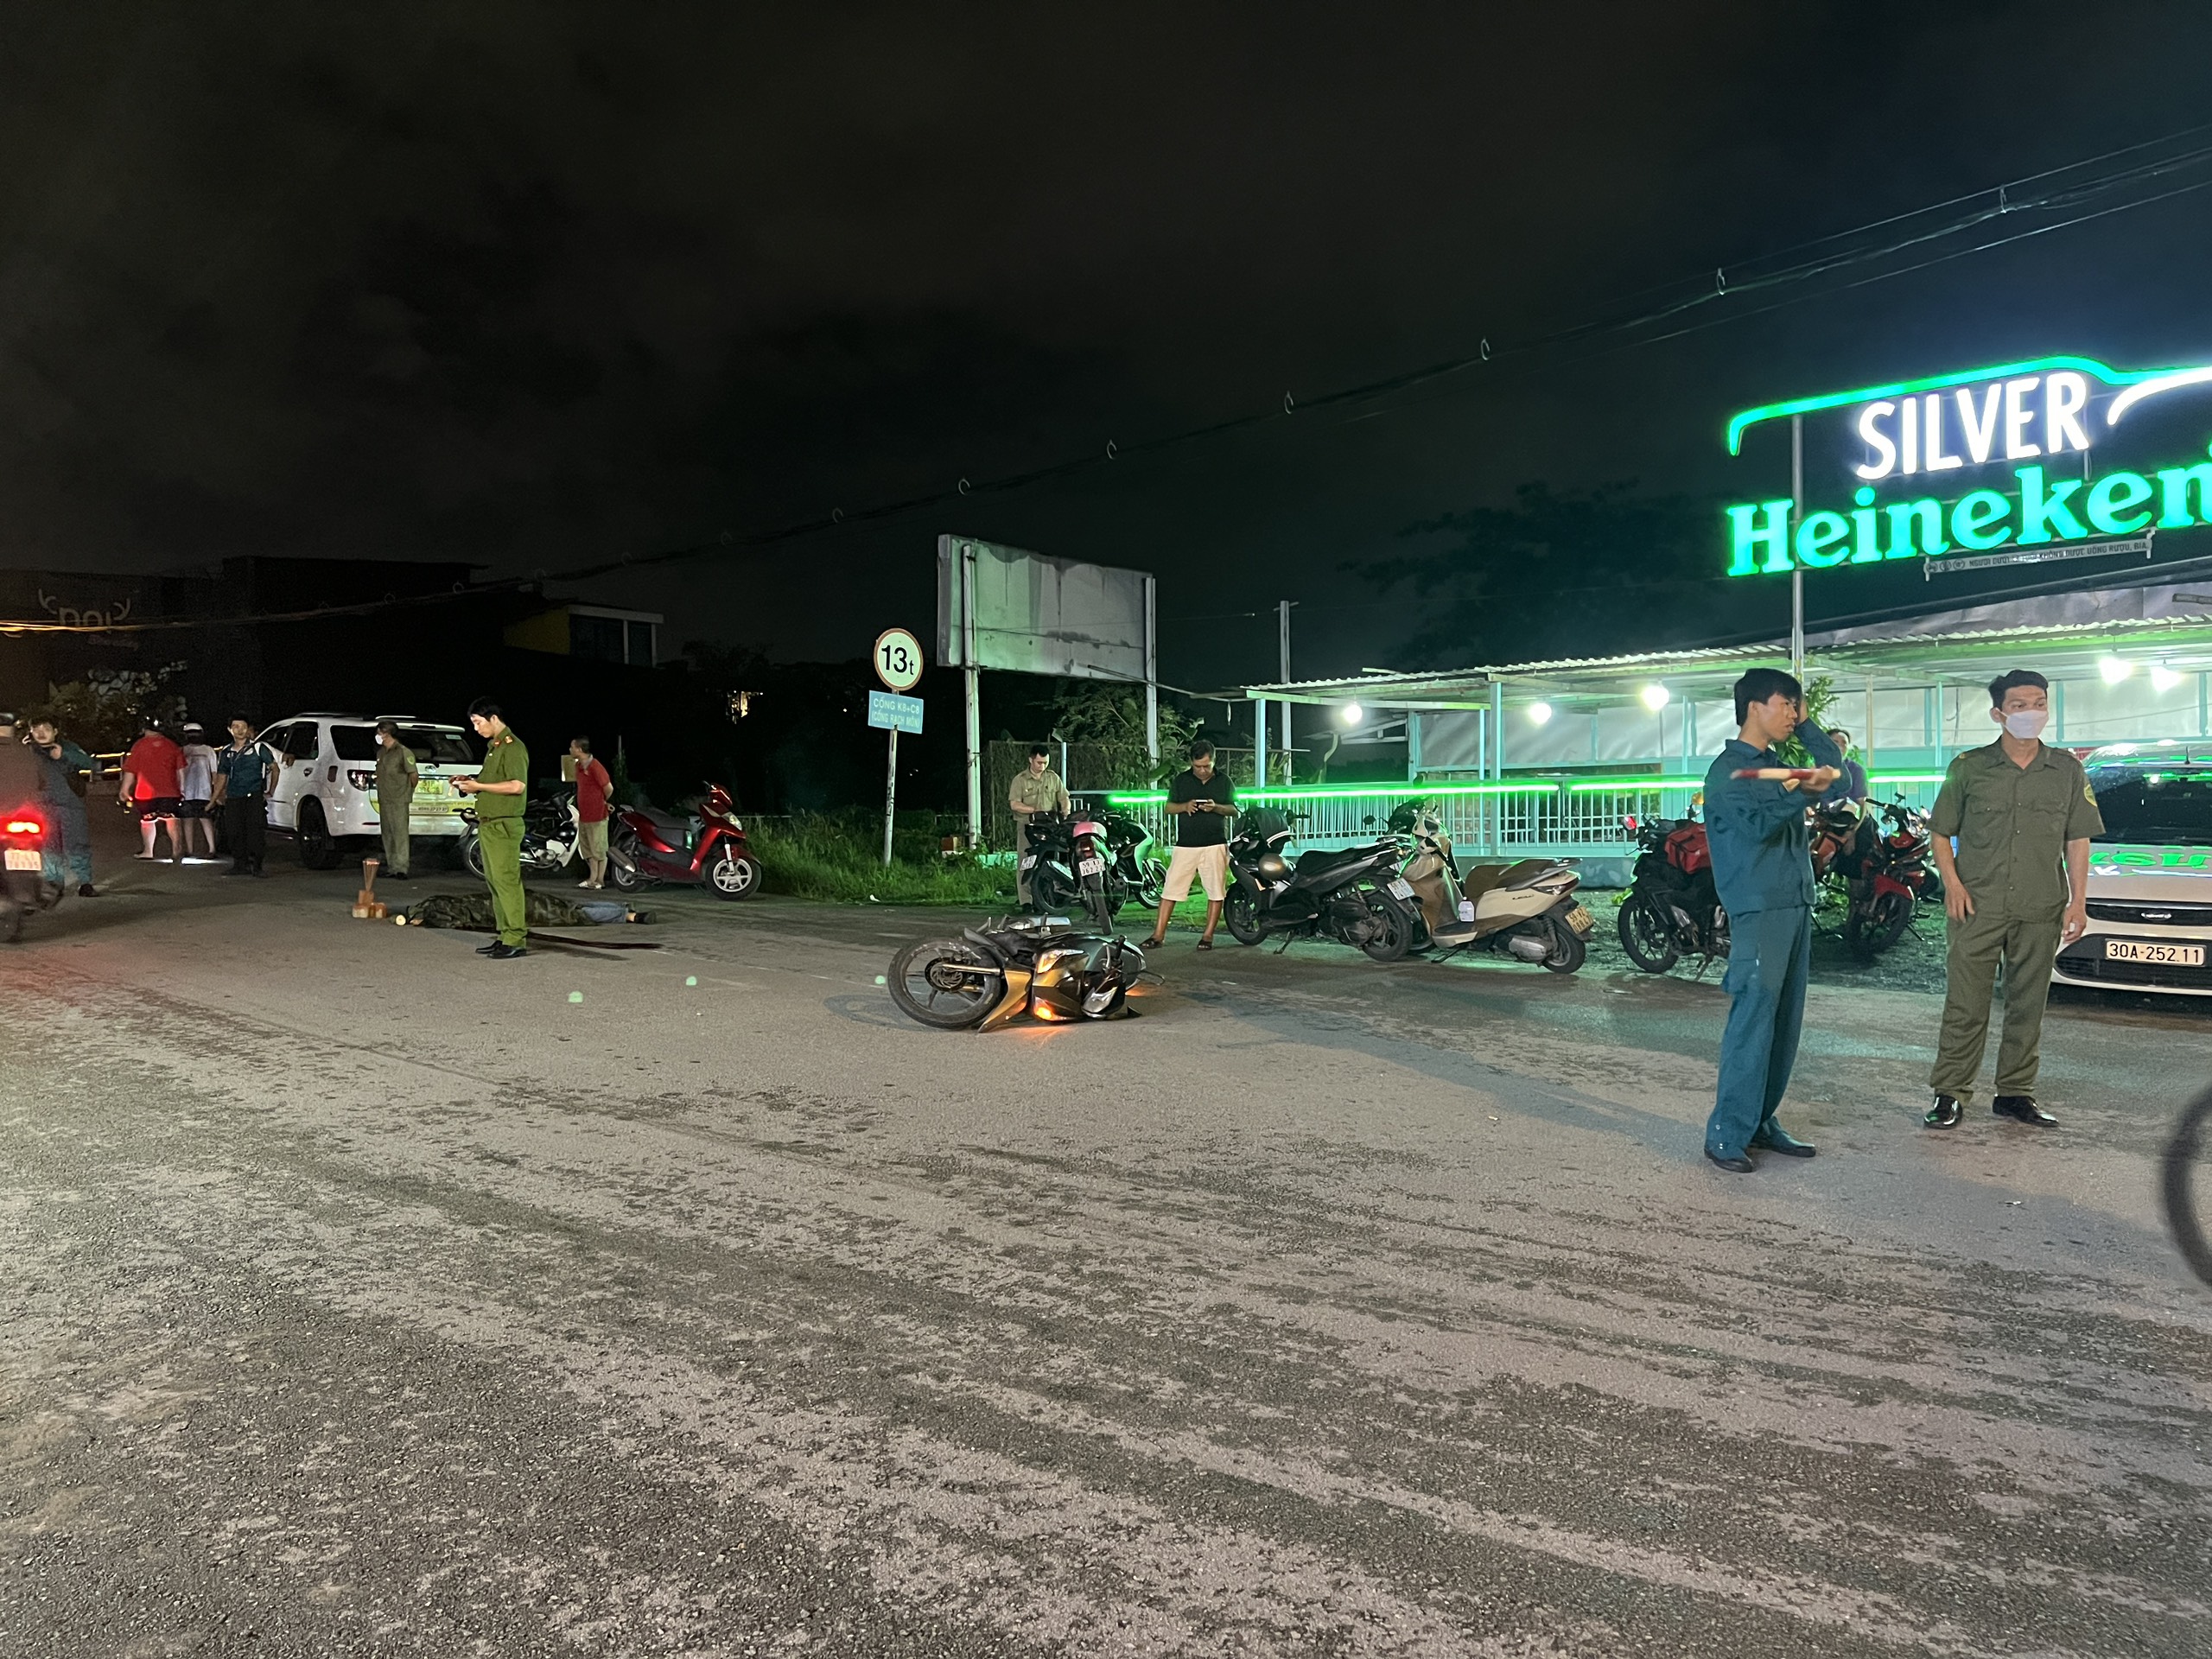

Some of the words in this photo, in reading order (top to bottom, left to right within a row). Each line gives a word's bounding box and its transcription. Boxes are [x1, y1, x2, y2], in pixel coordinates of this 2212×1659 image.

[1856, 372, 2090, 480] SILVER
[1728, 461, 2212, 576] Heineken
[874, 696, 896, 710] CỐNG
